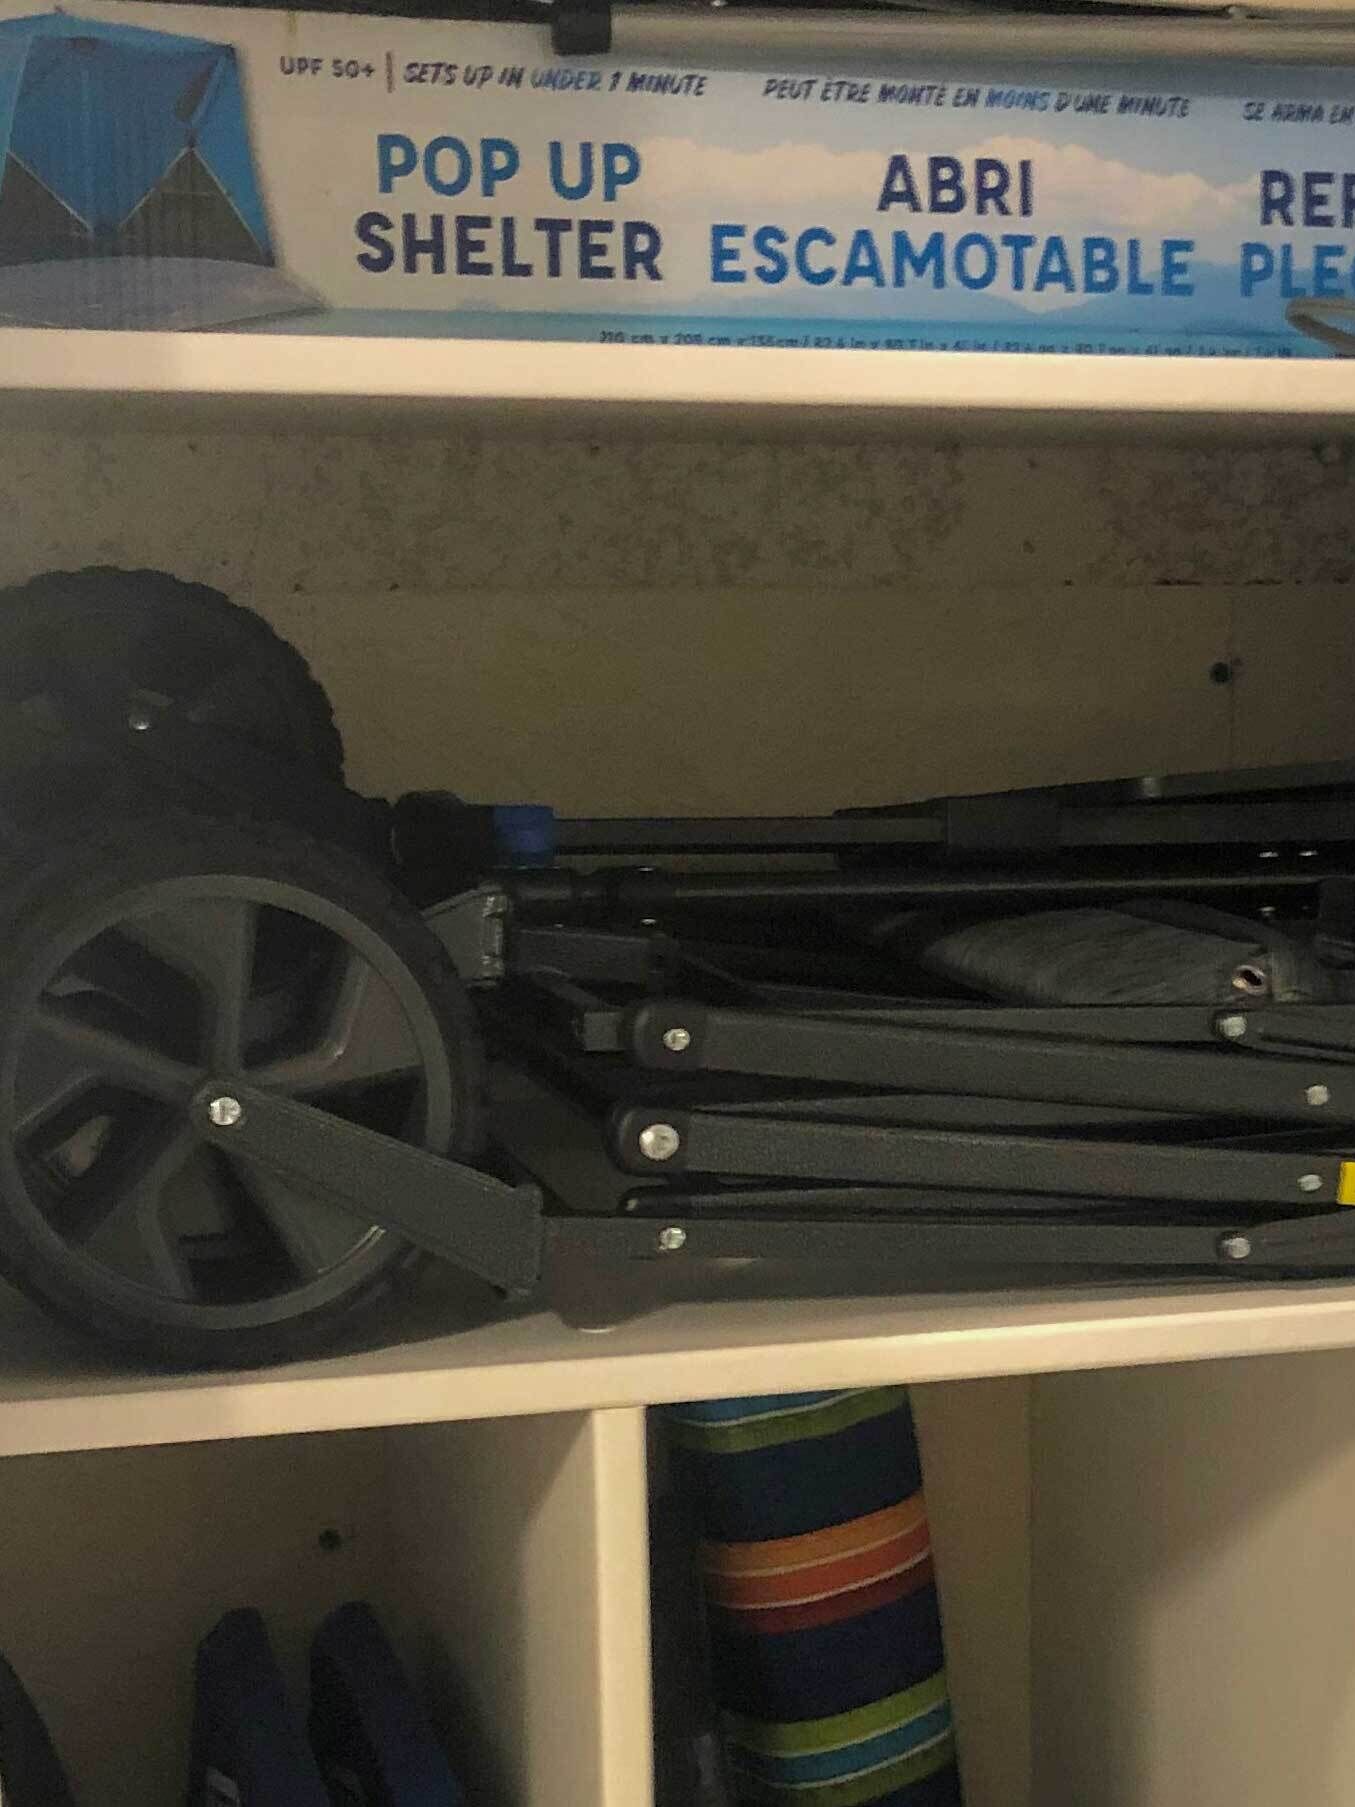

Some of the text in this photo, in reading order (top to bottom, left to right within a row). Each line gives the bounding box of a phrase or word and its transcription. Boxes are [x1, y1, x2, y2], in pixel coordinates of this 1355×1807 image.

[280, 56, 375, 79] UPF 50+
[404, 62, 708, 96] SETS UP IN UNDER 1 MINUTE
[762, 78, 817, 99] PEUT
[952, 87, 980, 108] EN
[984, 87, 1050, 112] MOINS
[1116, 94, 1191, 118] MINUTE
[1243, 102, 1265, 121] SE
[1329, 104, 1355, 125] EN
[377, 134, 643, 201] POP UP
[876, 154, 1034, 218] ABRI
[354, 211, 663, 281] SHELTER
[710, 223, 1196, 298] ESCAMOTABLE
